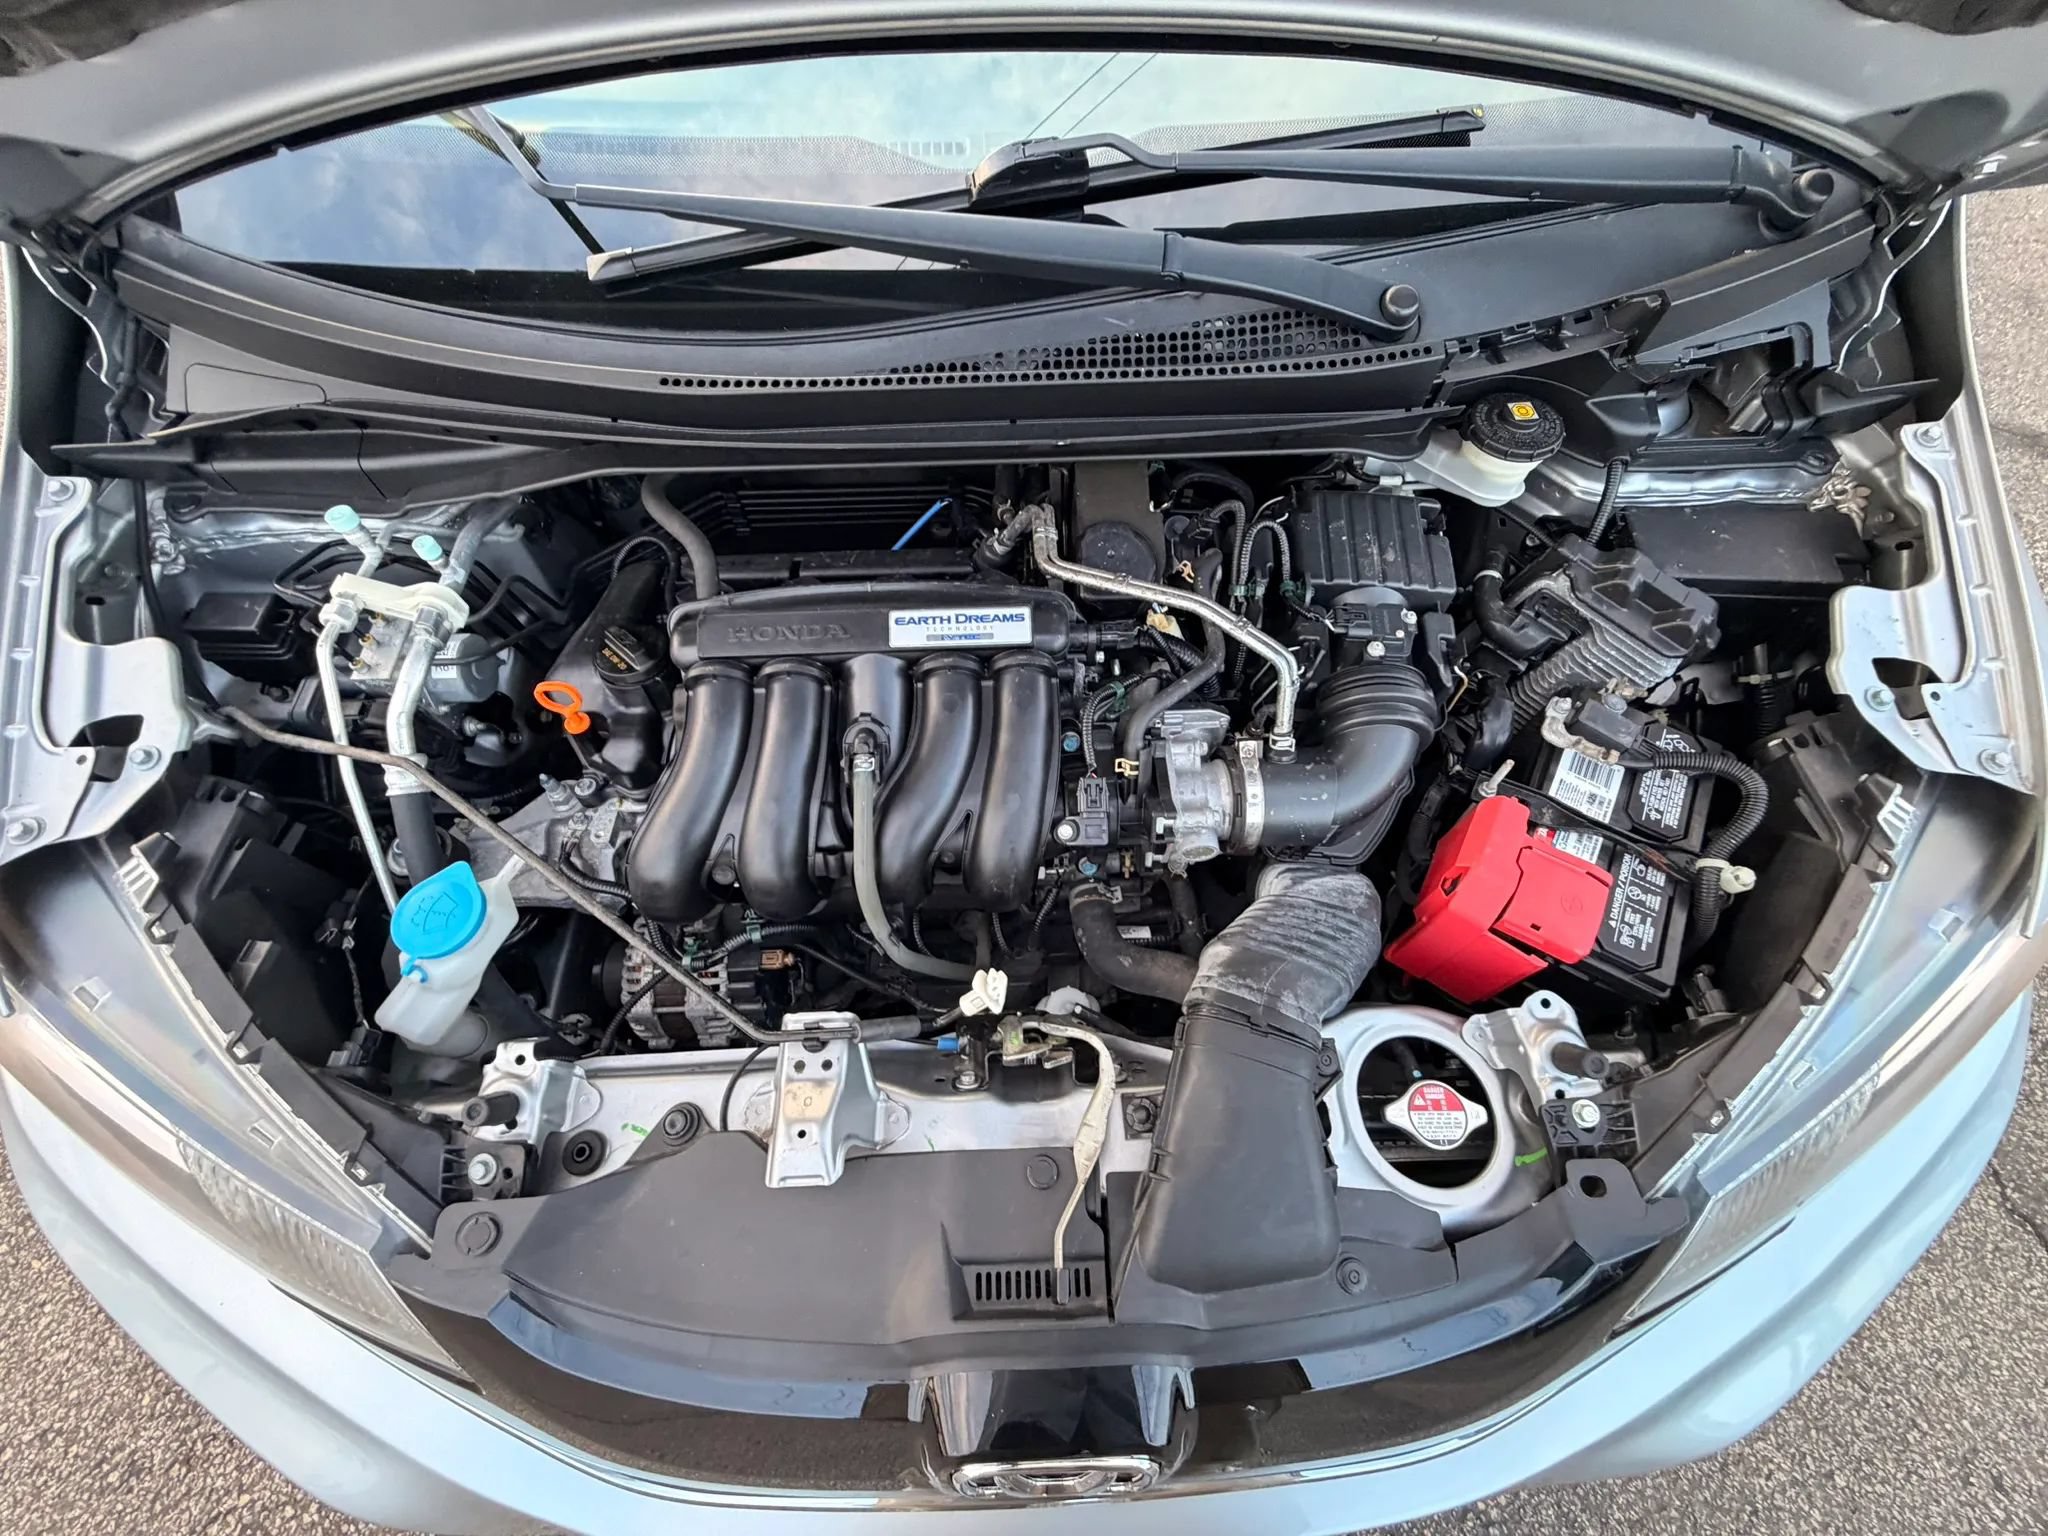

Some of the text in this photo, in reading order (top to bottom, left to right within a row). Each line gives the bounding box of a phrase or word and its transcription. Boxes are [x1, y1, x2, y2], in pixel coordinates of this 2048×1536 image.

[894, 613, 1025, 625] EARTH DREAMS
[727, 624, 851, 642] HONDA
[1609, 887, 1624, 920] DANGER
[1618, 853, 1632, 881] POISON
